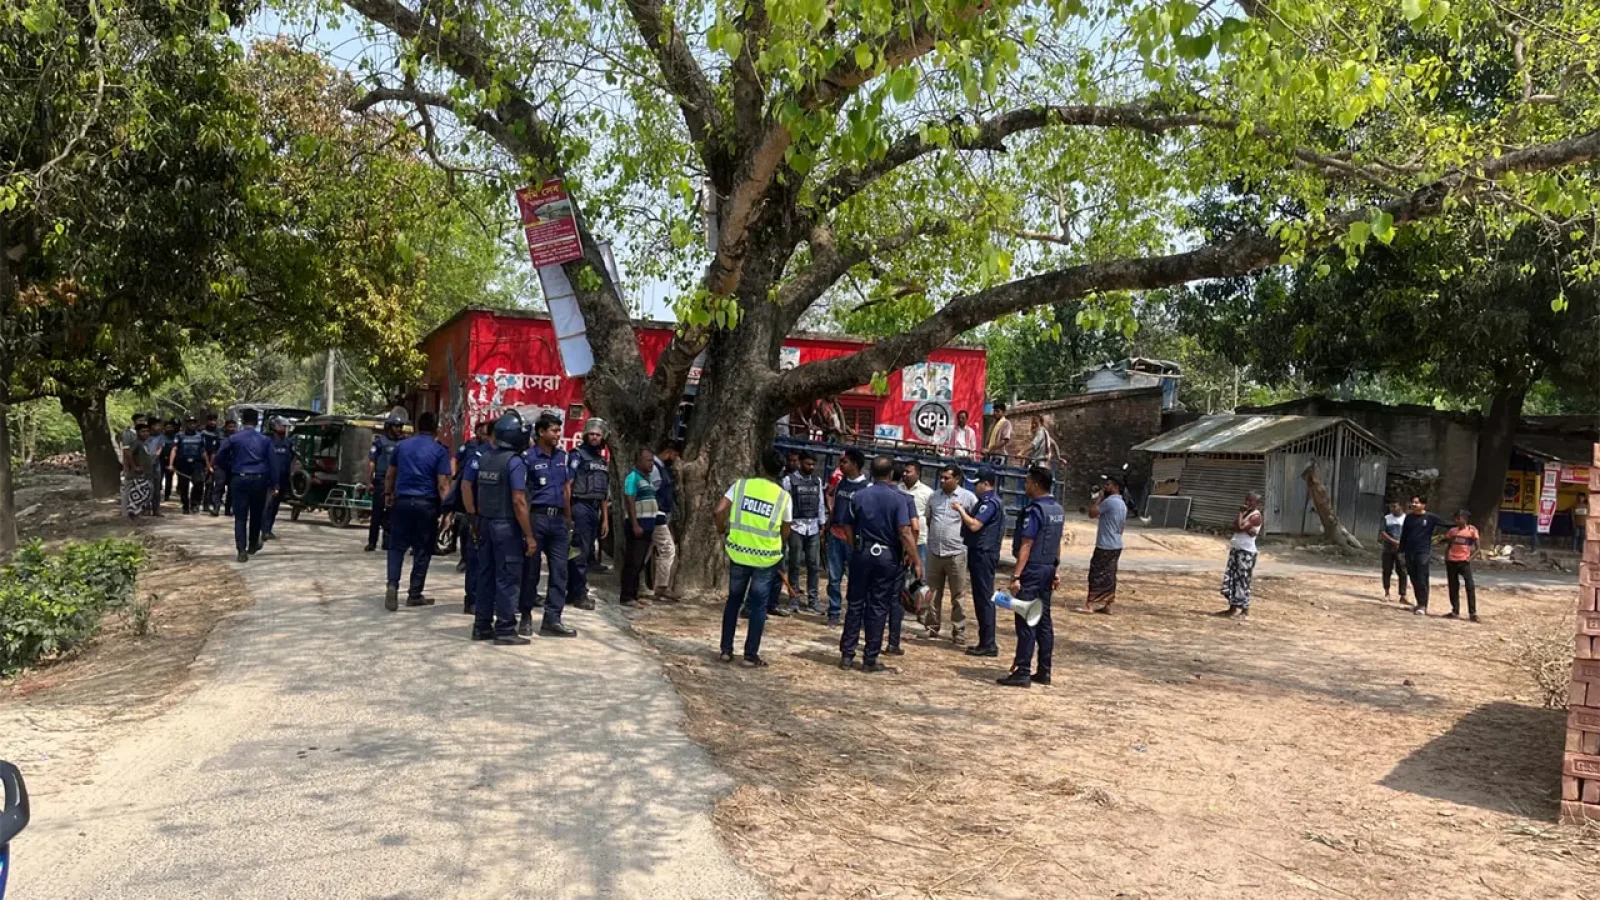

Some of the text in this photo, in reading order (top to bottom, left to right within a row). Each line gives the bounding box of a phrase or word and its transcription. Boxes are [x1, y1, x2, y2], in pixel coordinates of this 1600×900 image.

[917, 411, 947, 430] GPH
[478, 470, 499, 481] POLICE
[742, 497, 773, 517] POLICE
